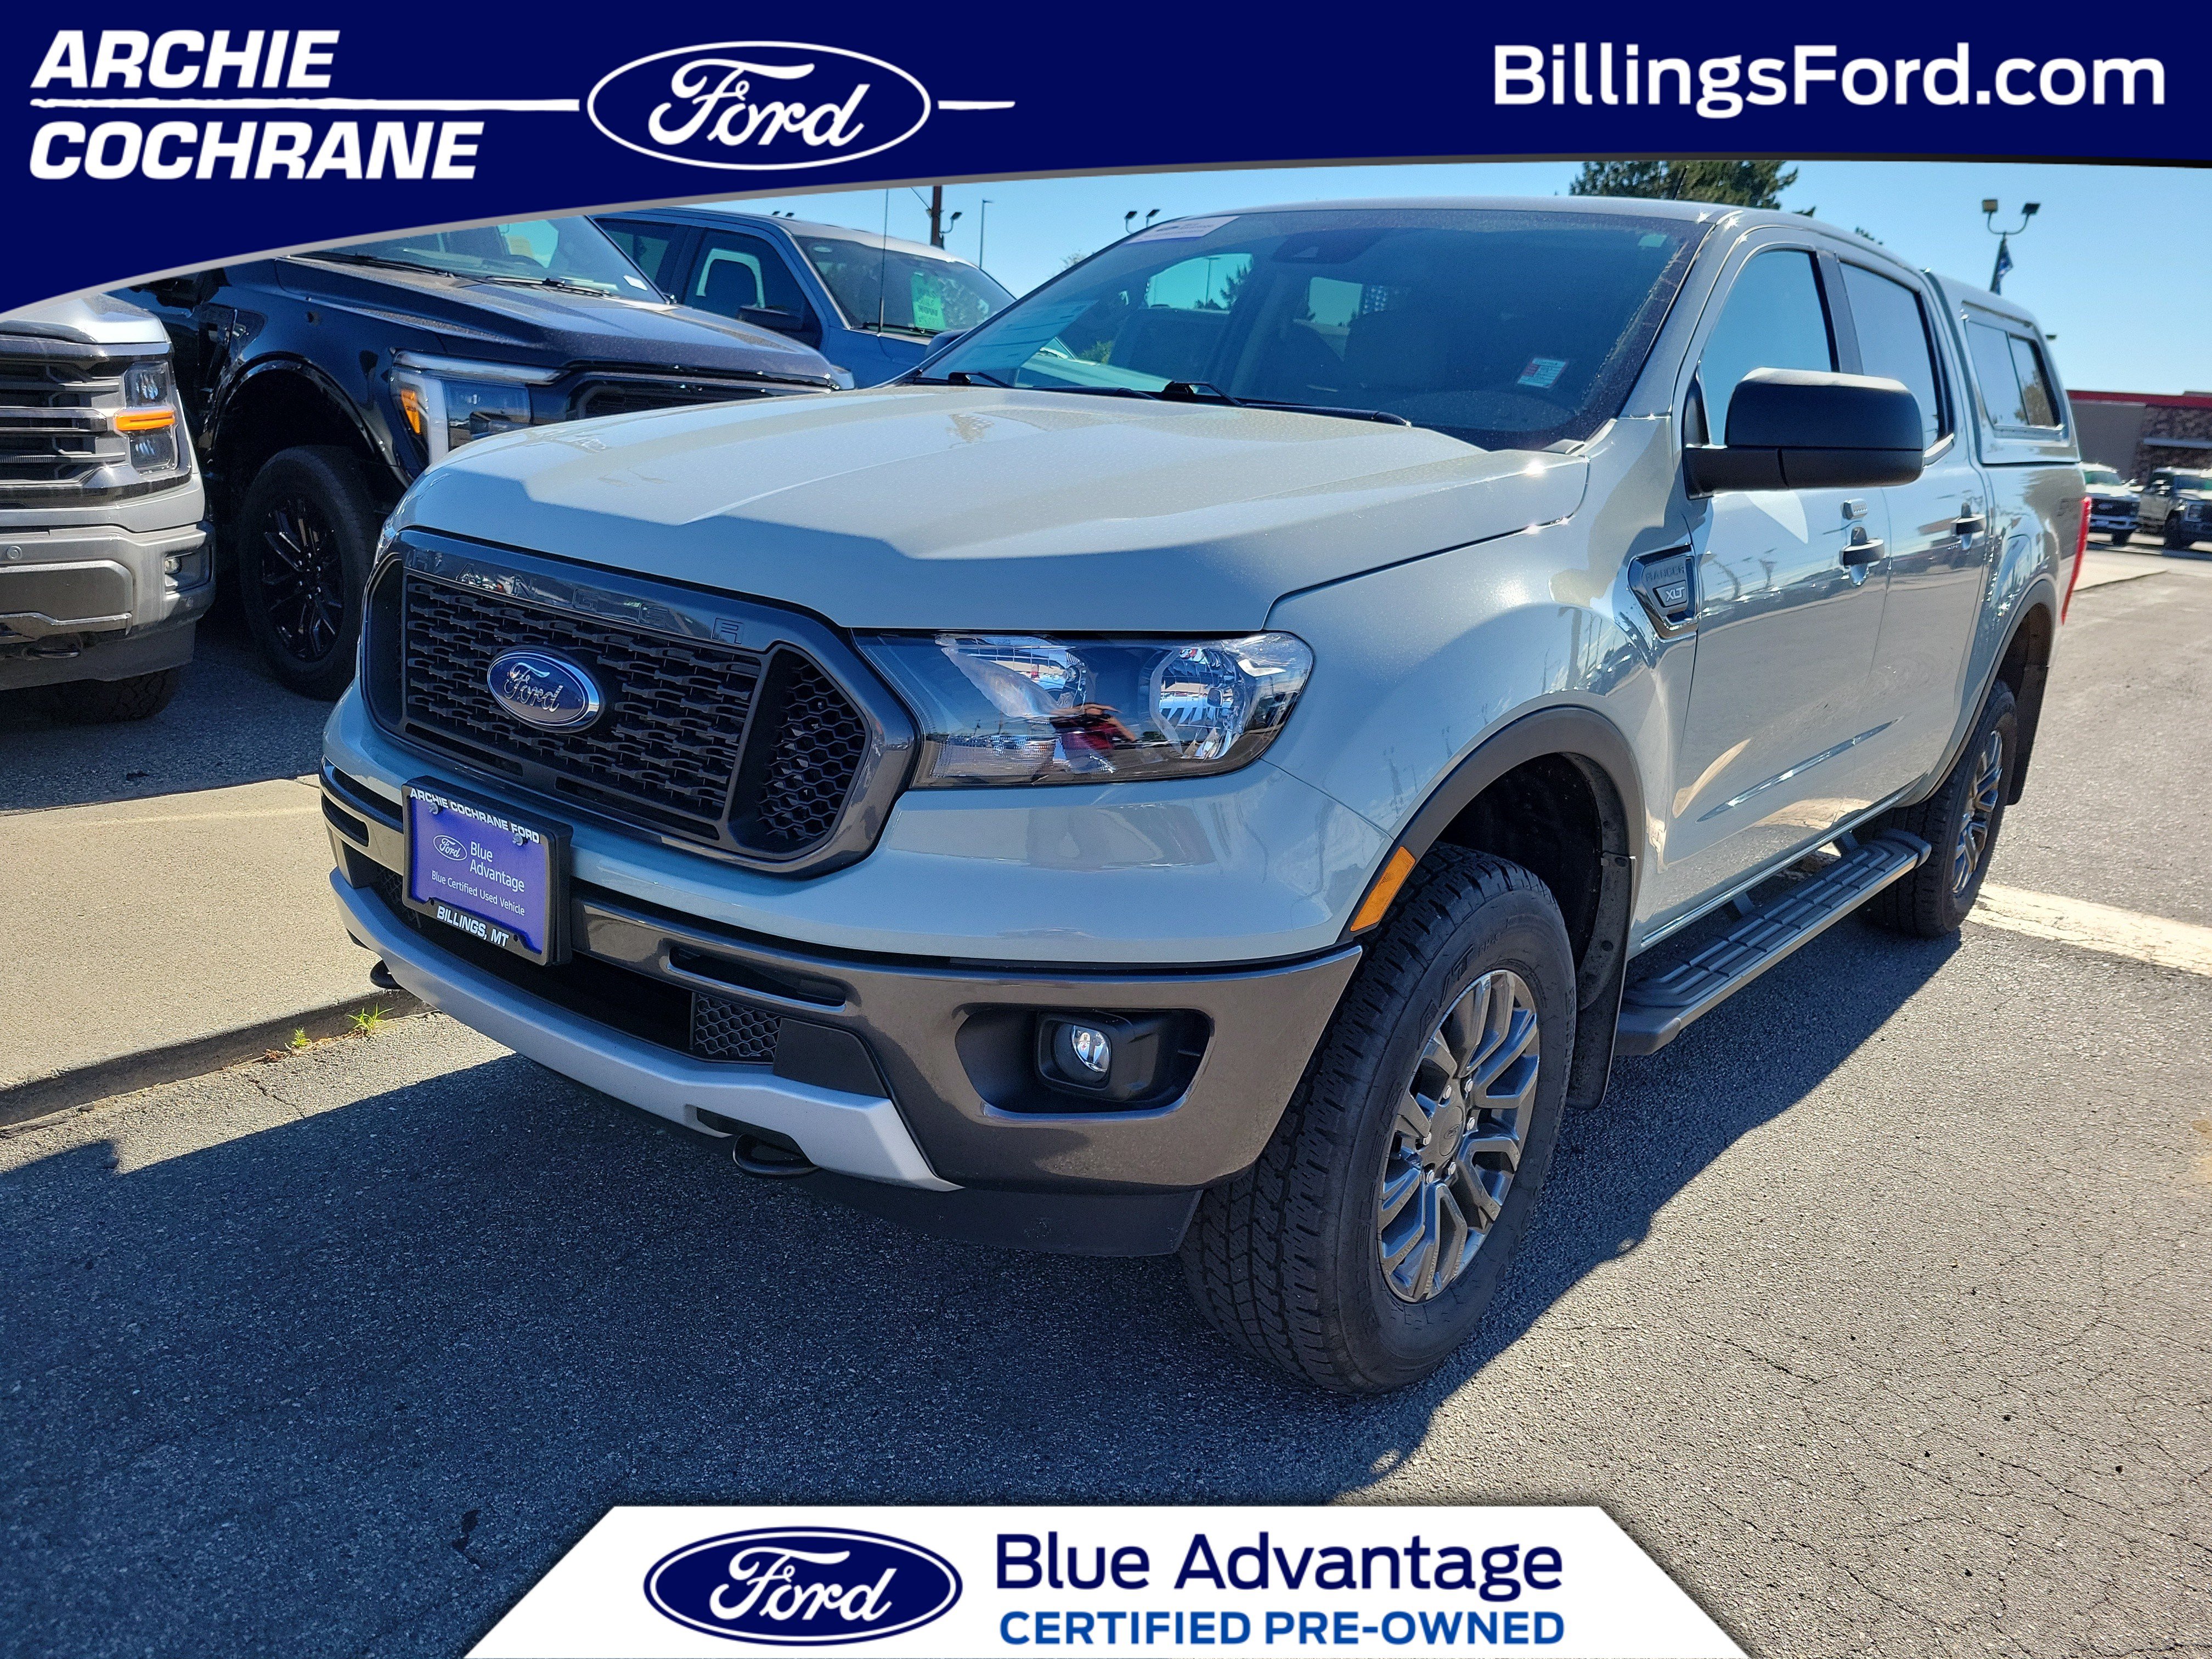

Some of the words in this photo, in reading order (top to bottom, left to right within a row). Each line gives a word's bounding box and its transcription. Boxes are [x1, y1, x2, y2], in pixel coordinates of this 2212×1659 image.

[1665, 586, 1685, 602] XLT
[504, 662, 564, 713] Ford
[410, 788, 449, 809] ARCHIE
[450, 802, 508, 831] COCHRANE
[510, 822, 540, 844] FORD
[439, 837, 460, 859] Ford
[470, 841, 493, 863] Blue
[431, 870, 446, 885] Blue
[447, 877, 478, 897] Certified
[479, 889, 498, 905] Used
[499, 898, 525, 916] Vehicle
[469, 859, 525, 893] Advantage
[436, 906, 488, 940] BILLINGS,
[490, 930, 509, 947] MT
